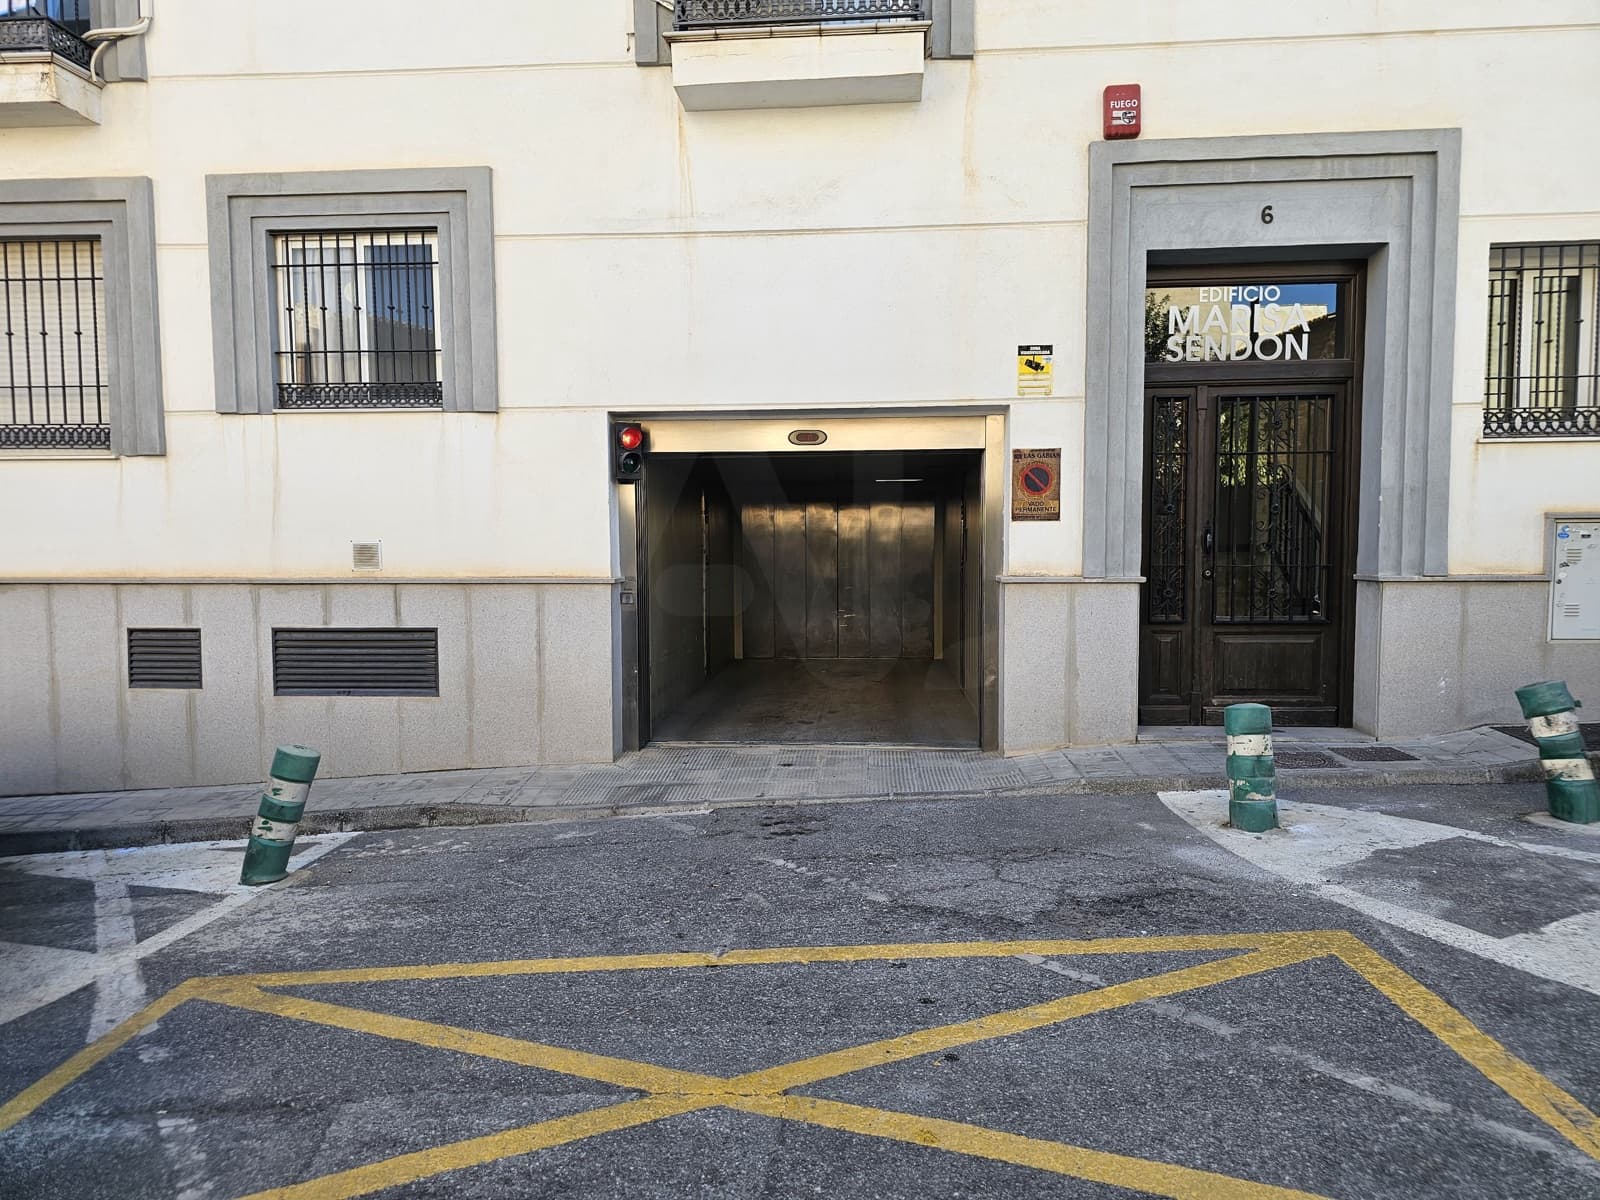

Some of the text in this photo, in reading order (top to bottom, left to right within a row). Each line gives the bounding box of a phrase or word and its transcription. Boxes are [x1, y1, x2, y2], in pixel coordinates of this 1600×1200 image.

[1110, 99, 1138, 109] FUEGO
[1261, 205, 1274, 225] 6
[1199, 285, 1281, 303] EDIFICIO
[1168, 302, 1311, 335] MARISA
[1166, 333, 1309, 362] SENDON
